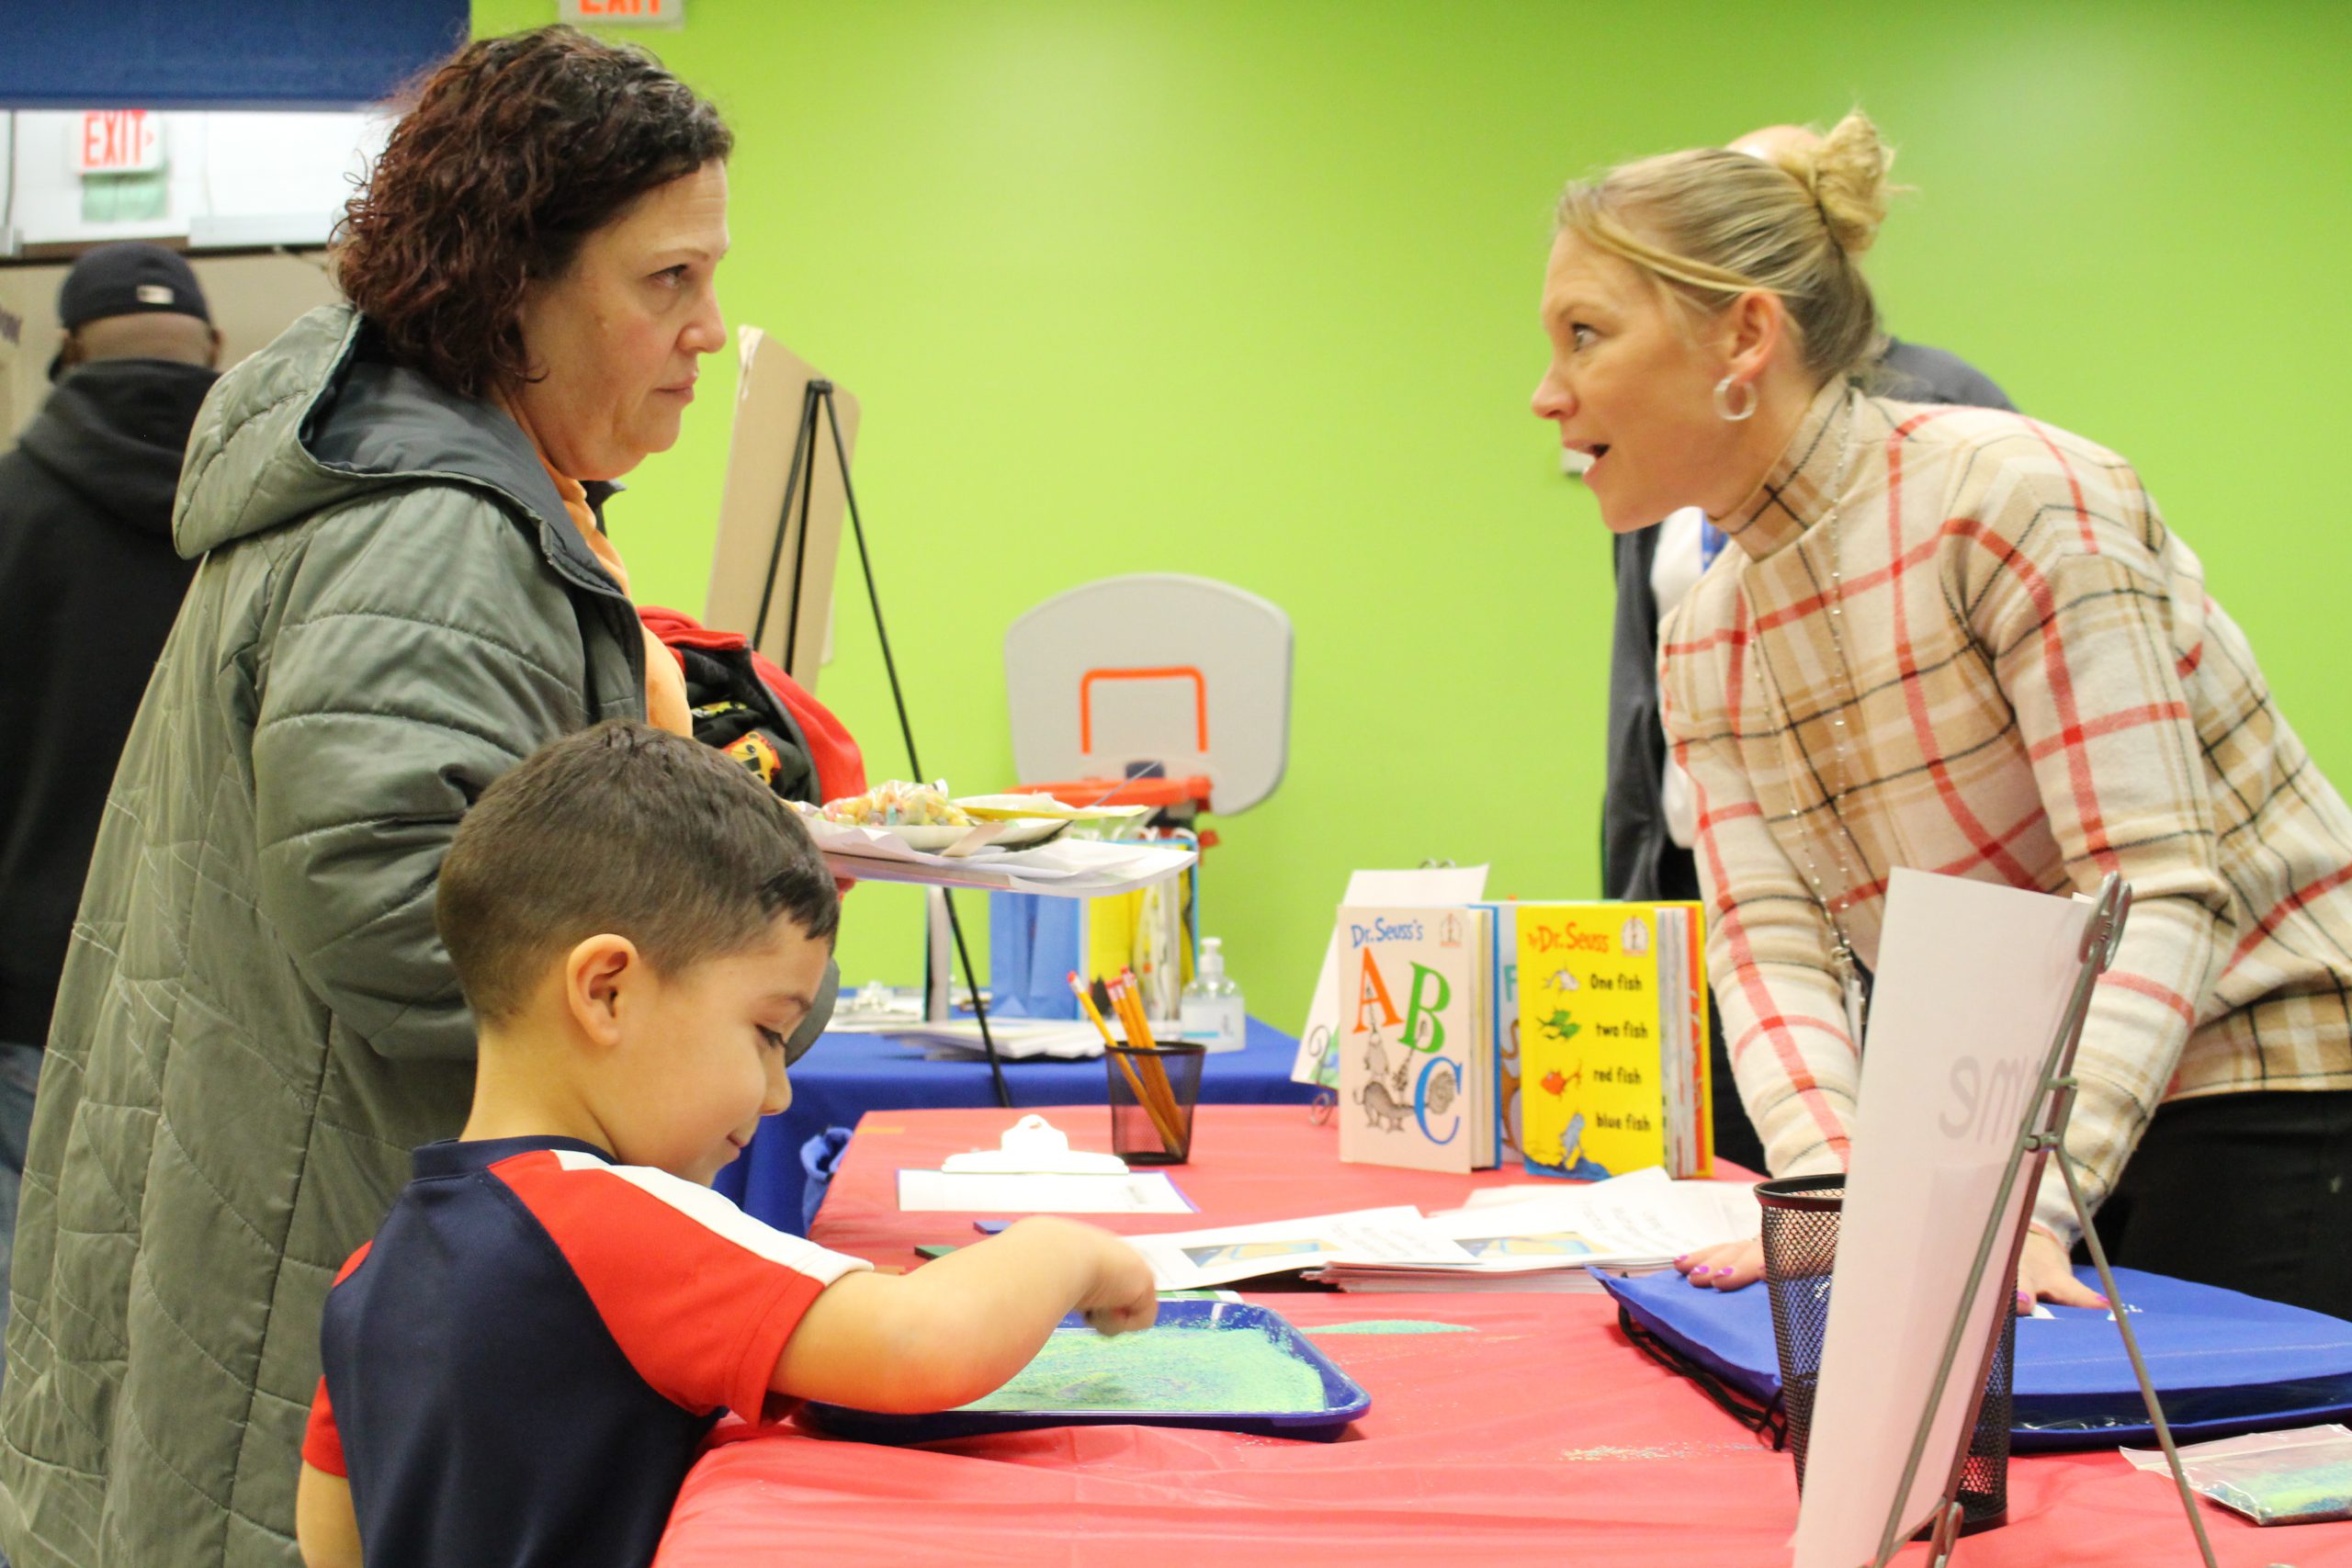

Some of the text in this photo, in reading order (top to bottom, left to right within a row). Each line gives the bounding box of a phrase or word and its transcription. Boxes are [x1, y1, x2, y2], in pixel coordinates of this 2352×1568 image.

[84, 108, 147, 167] EXIT
[1351, 924, 1374, 948] Dr.
[1374, 917, 1423, 942] Seuss's
[1537, 925, 1564, 953] Dr.
[1566, 921, 1609, 953] Seuss
[1590, 974, 1643, 991] One fish
[1596, 1021, 1648, 1039] two fish
[1593, 1066, 1642, 1085] red fish
[1596, 1111, 1651, 1131] blue fish
